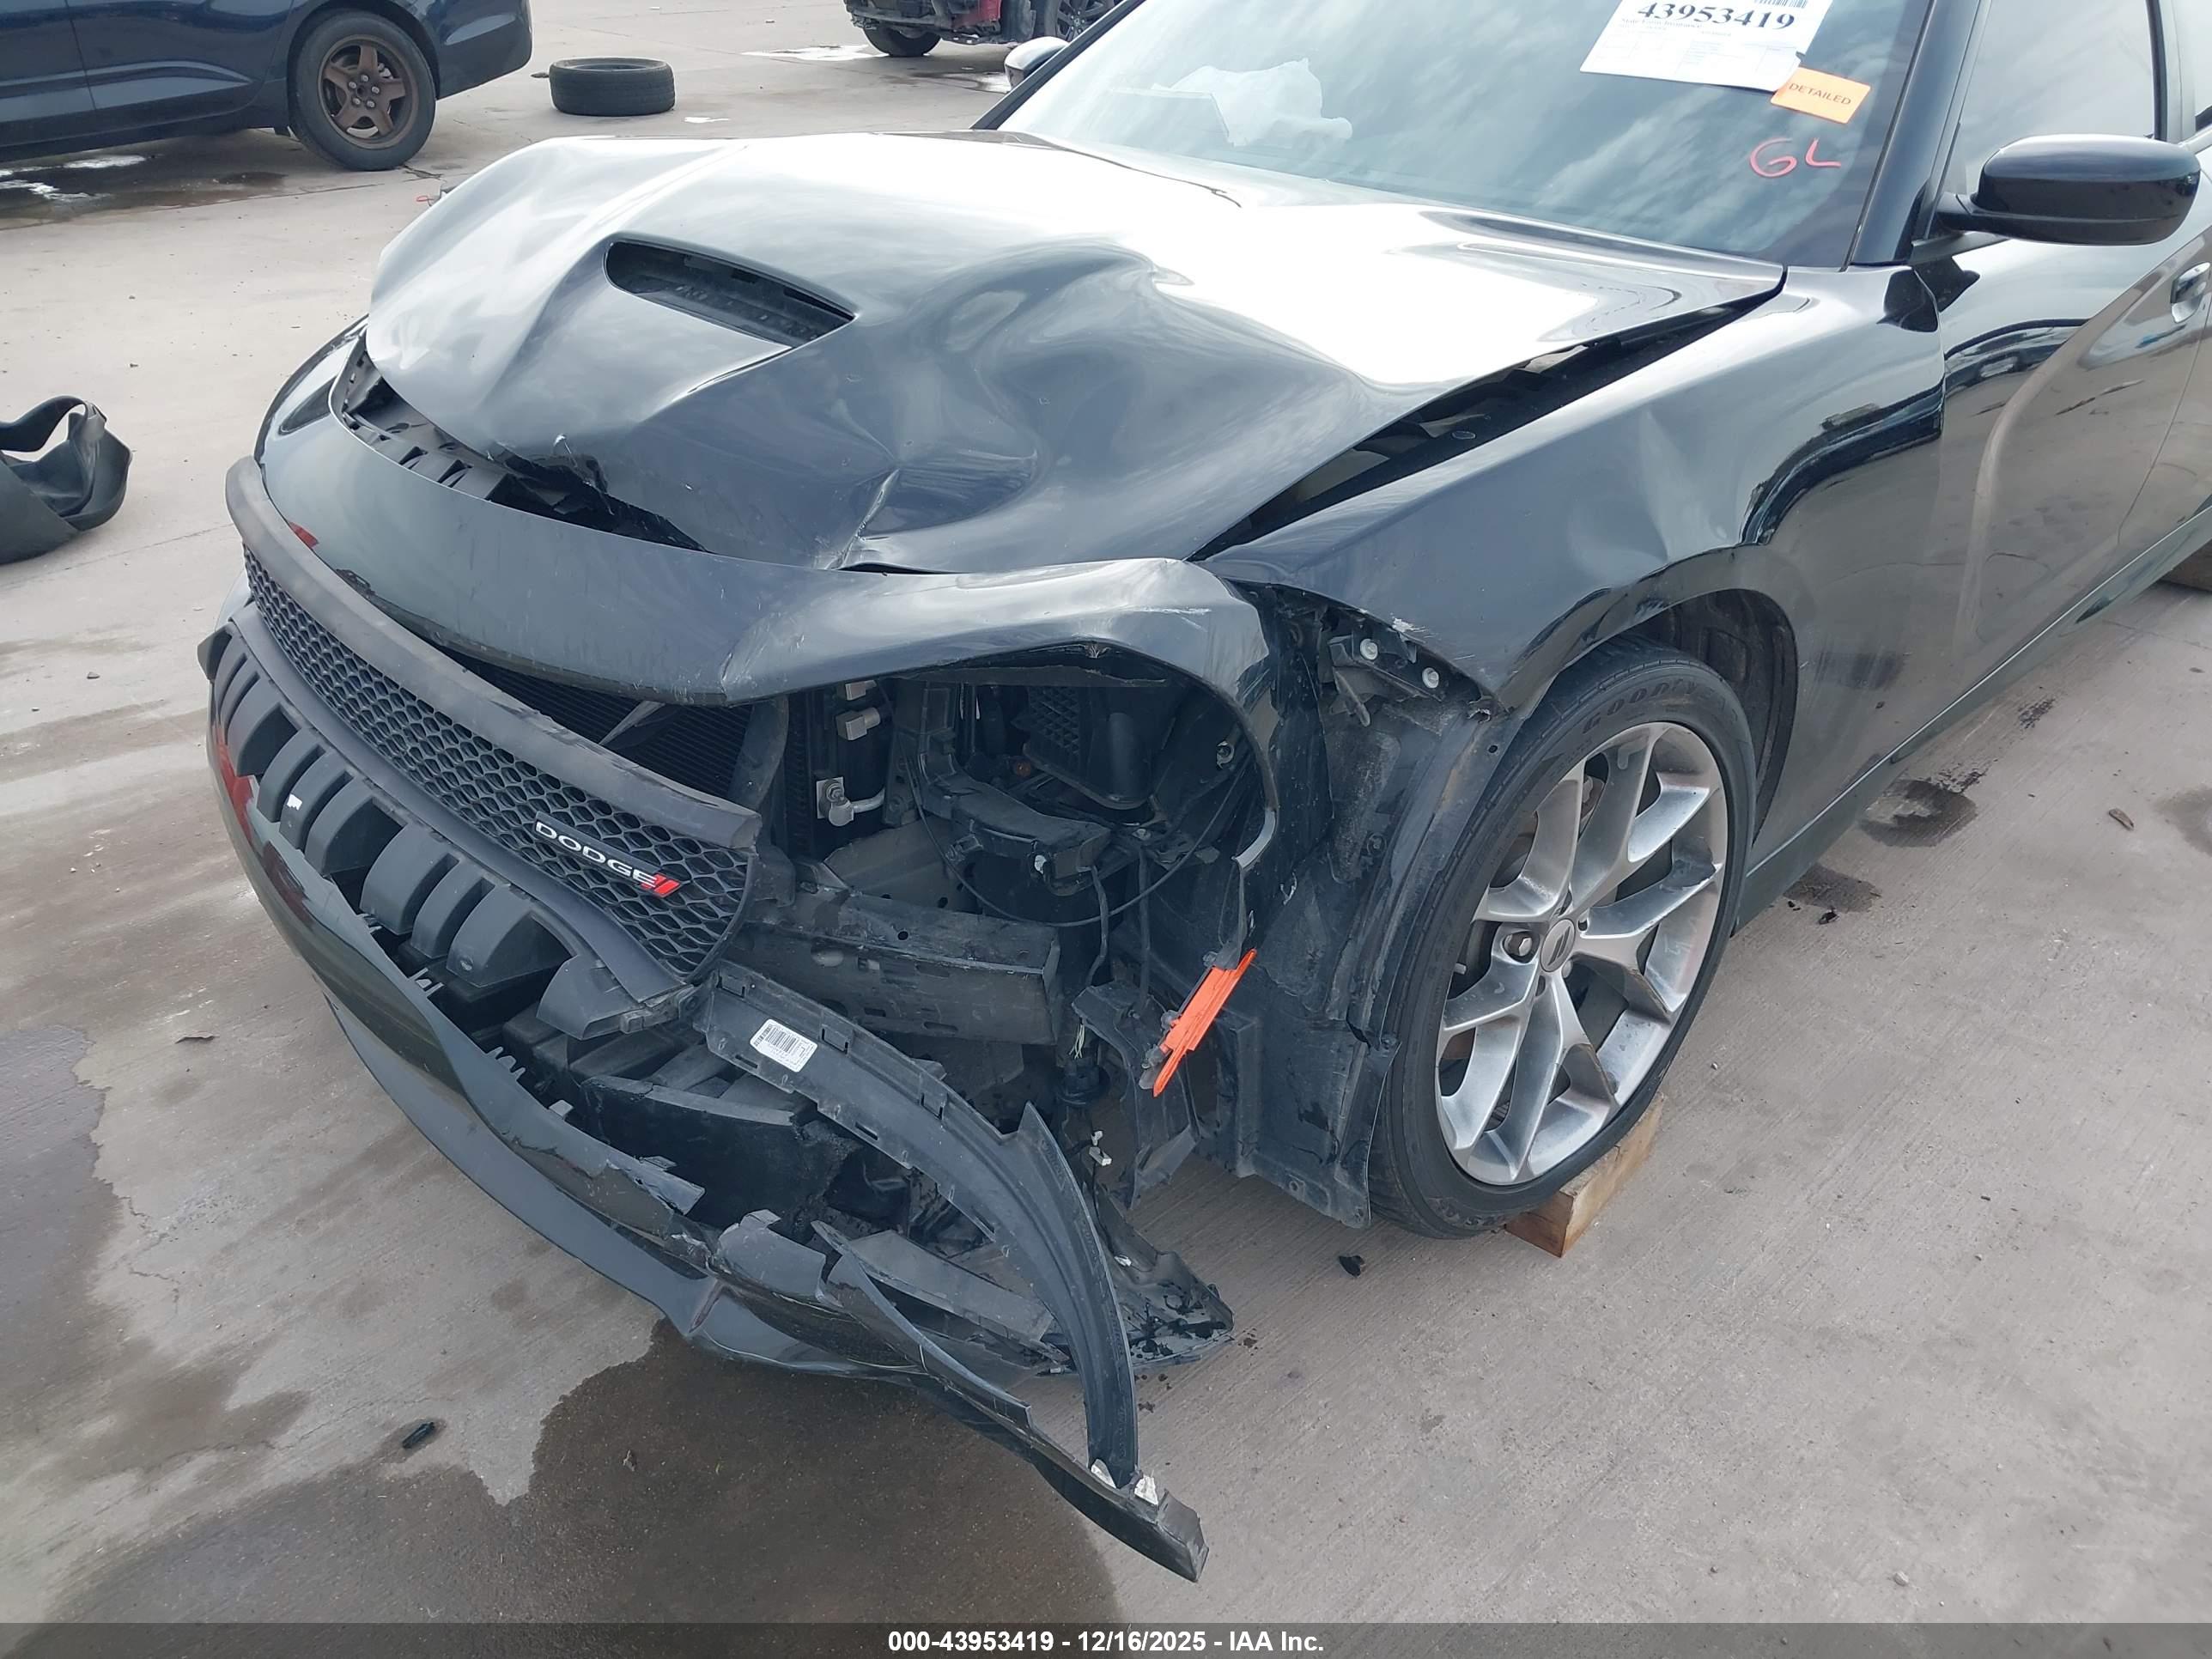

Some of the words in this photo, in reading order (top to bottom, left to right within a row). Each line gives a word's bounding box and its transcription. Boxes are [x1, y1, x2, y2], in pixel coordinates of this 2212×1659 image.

[1638, 3, 1795, 30] 43953419
[1788, 82, 1851, 106] DETAILED
[535, 821, 659, 889] DODGE
